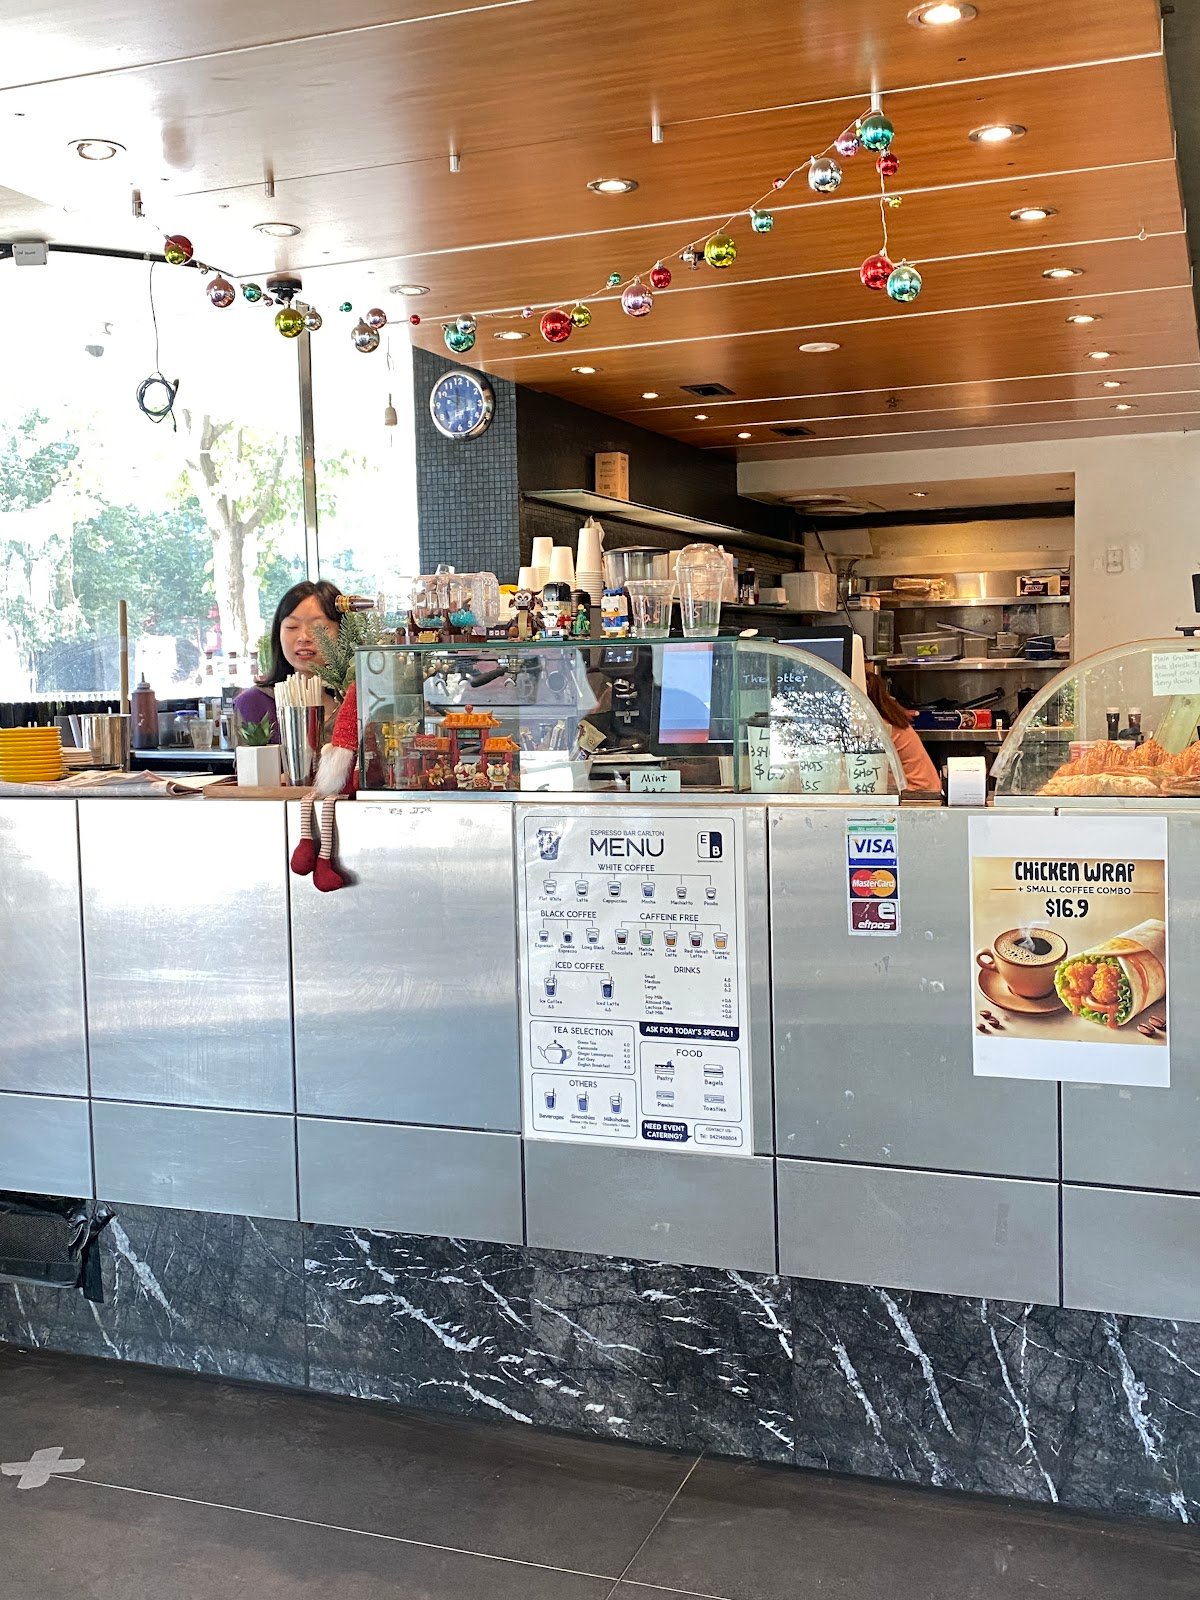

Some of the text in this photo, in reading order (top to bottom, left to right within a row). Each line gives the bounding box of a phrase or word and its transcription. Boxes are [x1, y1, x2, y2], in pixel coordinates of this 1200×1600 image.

[856, 755, 866, 766] S
[854, 767, 881, 780] SHOT
[641, 774, 668, 783] Mint
[590, 838, 664, 857] MENU
[855, 839, 894, 853] VISA
[1015, 862, 1134, 882] CHICKEN WRAP
[852, 880, 894, 888] MasterCard
[1046, 898, 1088, 918] $16.9
[858, 920, 890, 930] eftpos
[674, 966, 700, 974] DRINKS
[571, 1028, 614, 1036] SELECTION
[675, 1028, 702, 1036] TODAY'S
[704, 1029, 728, 1037] SPECIAL
[676, 1049, 702, 1058] FOOD
[647, 1132, 682, 1140] CATERING?
